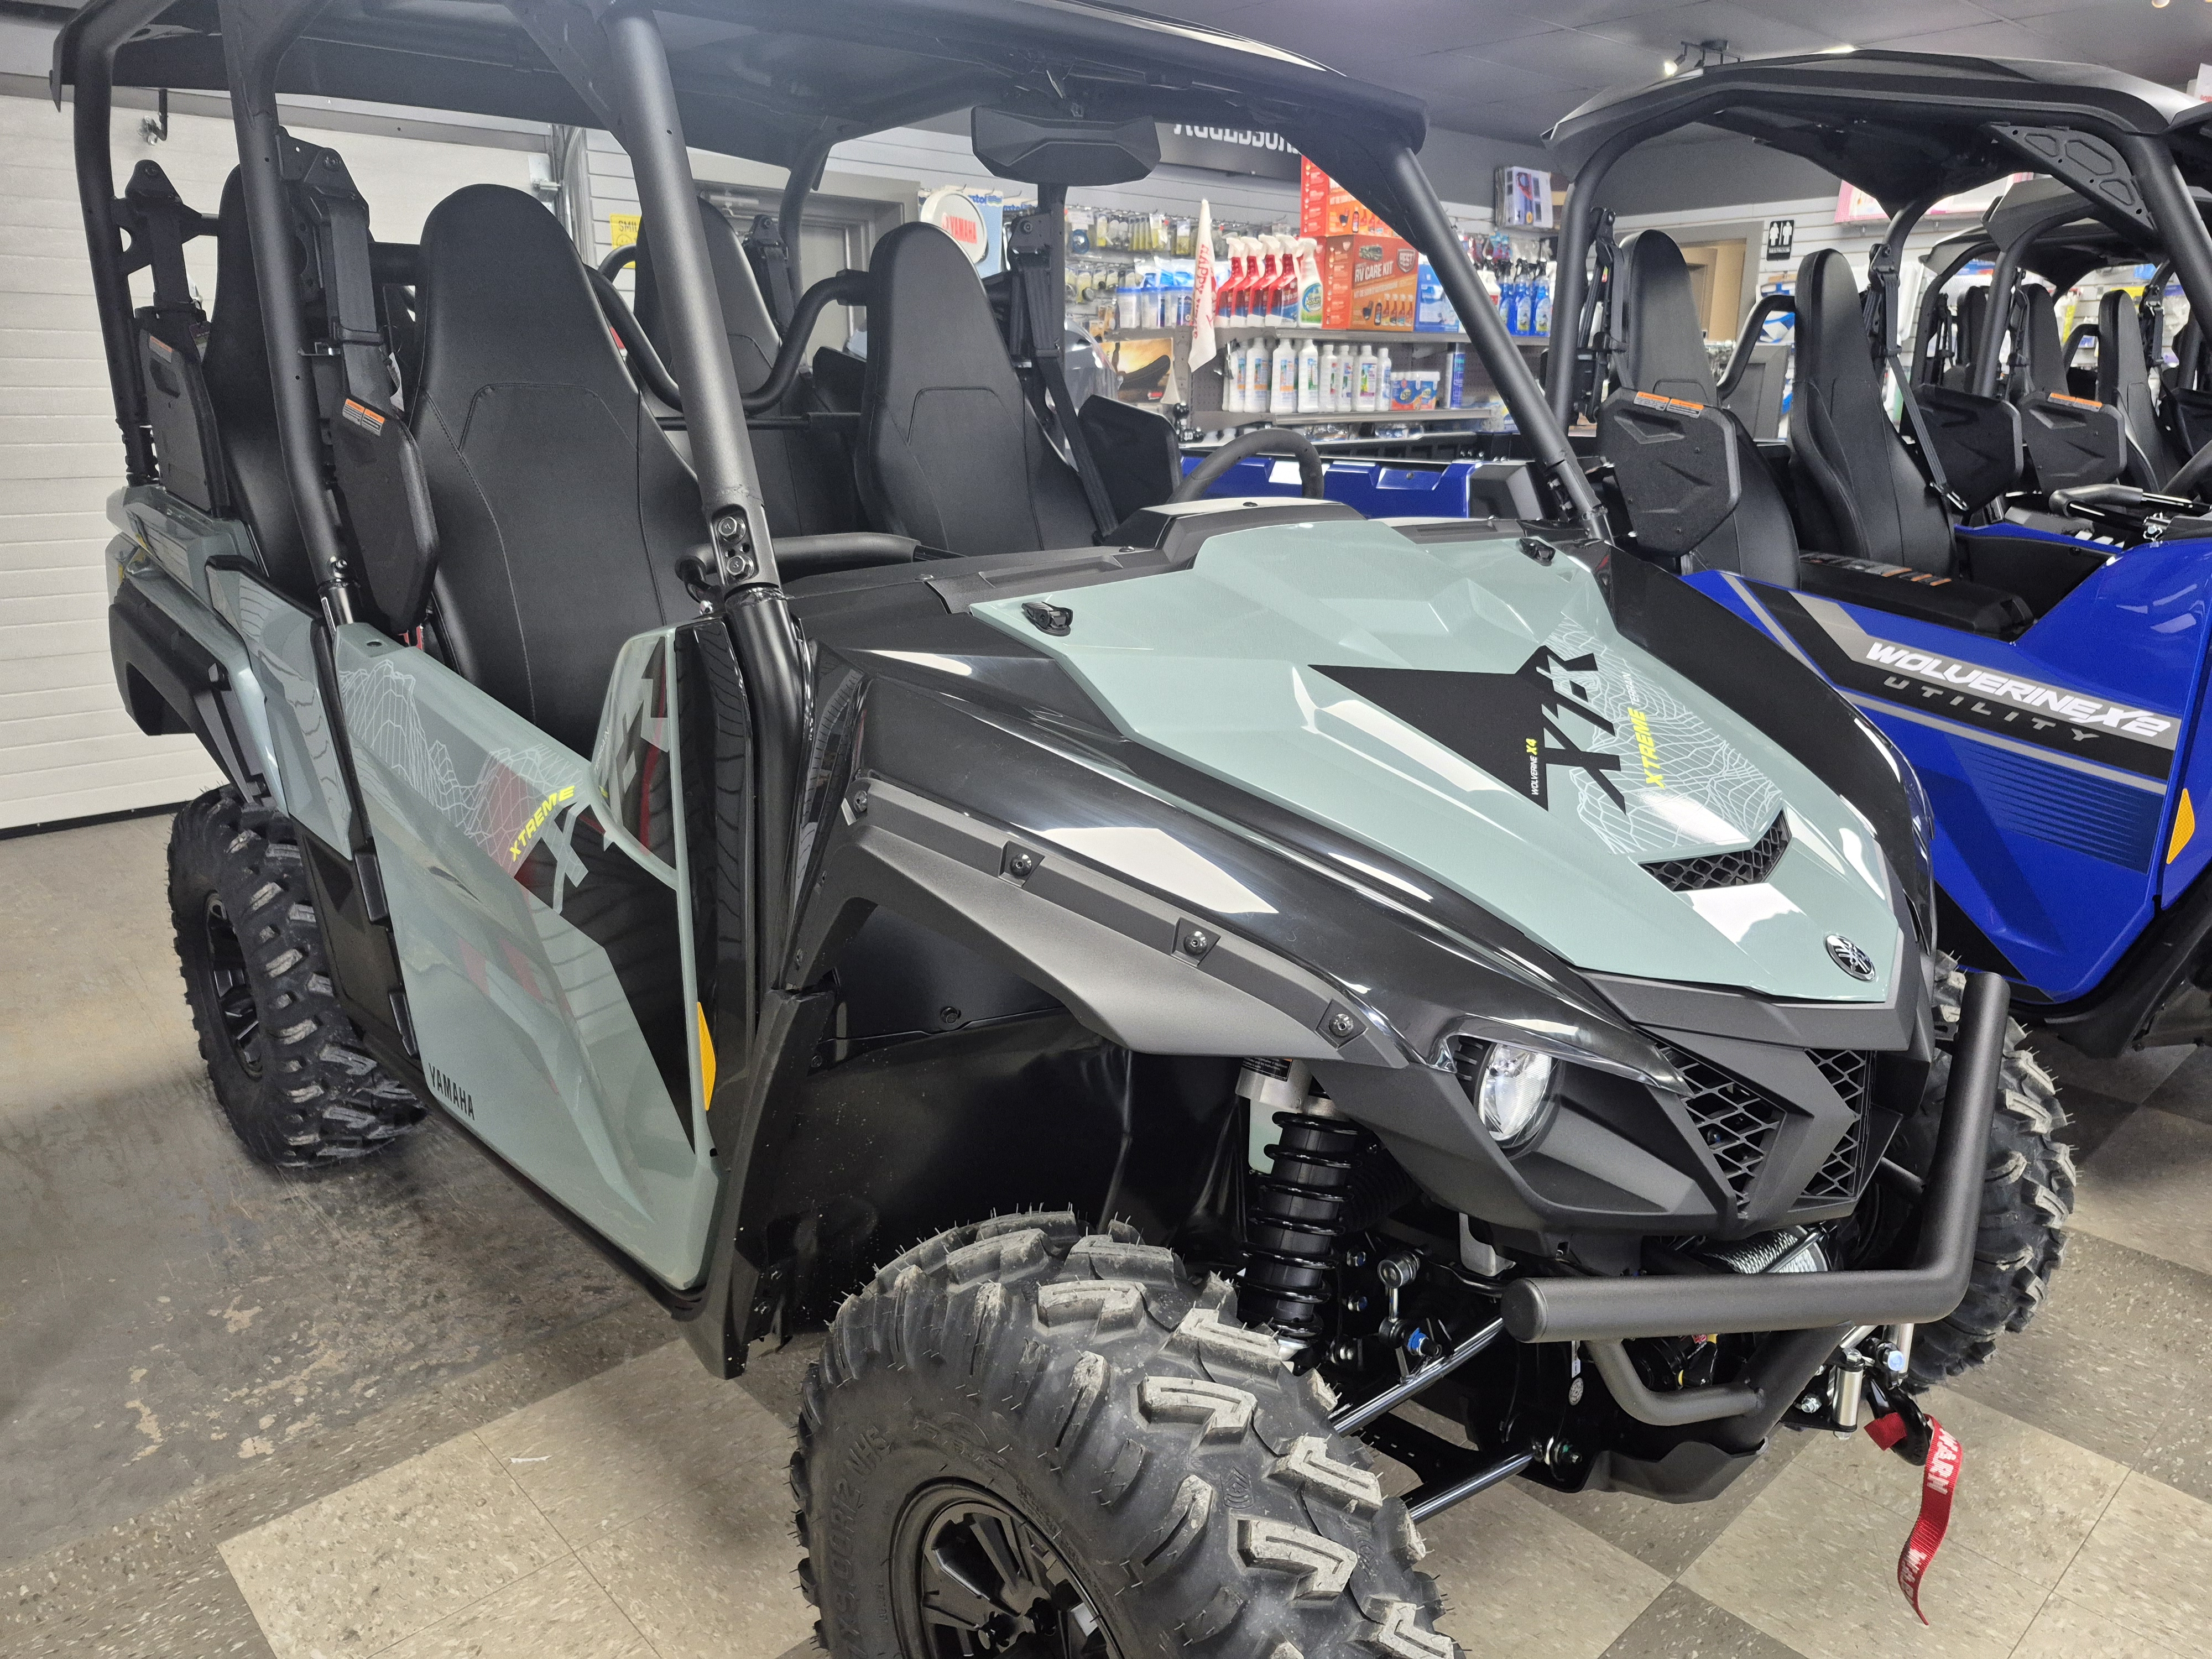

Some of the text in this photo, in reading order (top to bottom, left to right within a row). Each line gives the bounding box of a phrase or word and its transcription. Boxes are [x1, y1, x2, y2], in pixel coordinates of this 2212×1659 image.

[618, 220, 639, 232] SMIL
[1355, 260, 1394, 283] RV CARE KIT
[1621, 671, 1665, 789] XTREME TERRAIN
[1883, 676, 2100, 742] UTILITY
[1526, 738, 1540, 796] WOLVERINE X4
[510, 785, 575, 863] XTREME
[429, 1062, 475, 1121] YAMAHA
[1927, 1427, 1958, 1495] WARN
